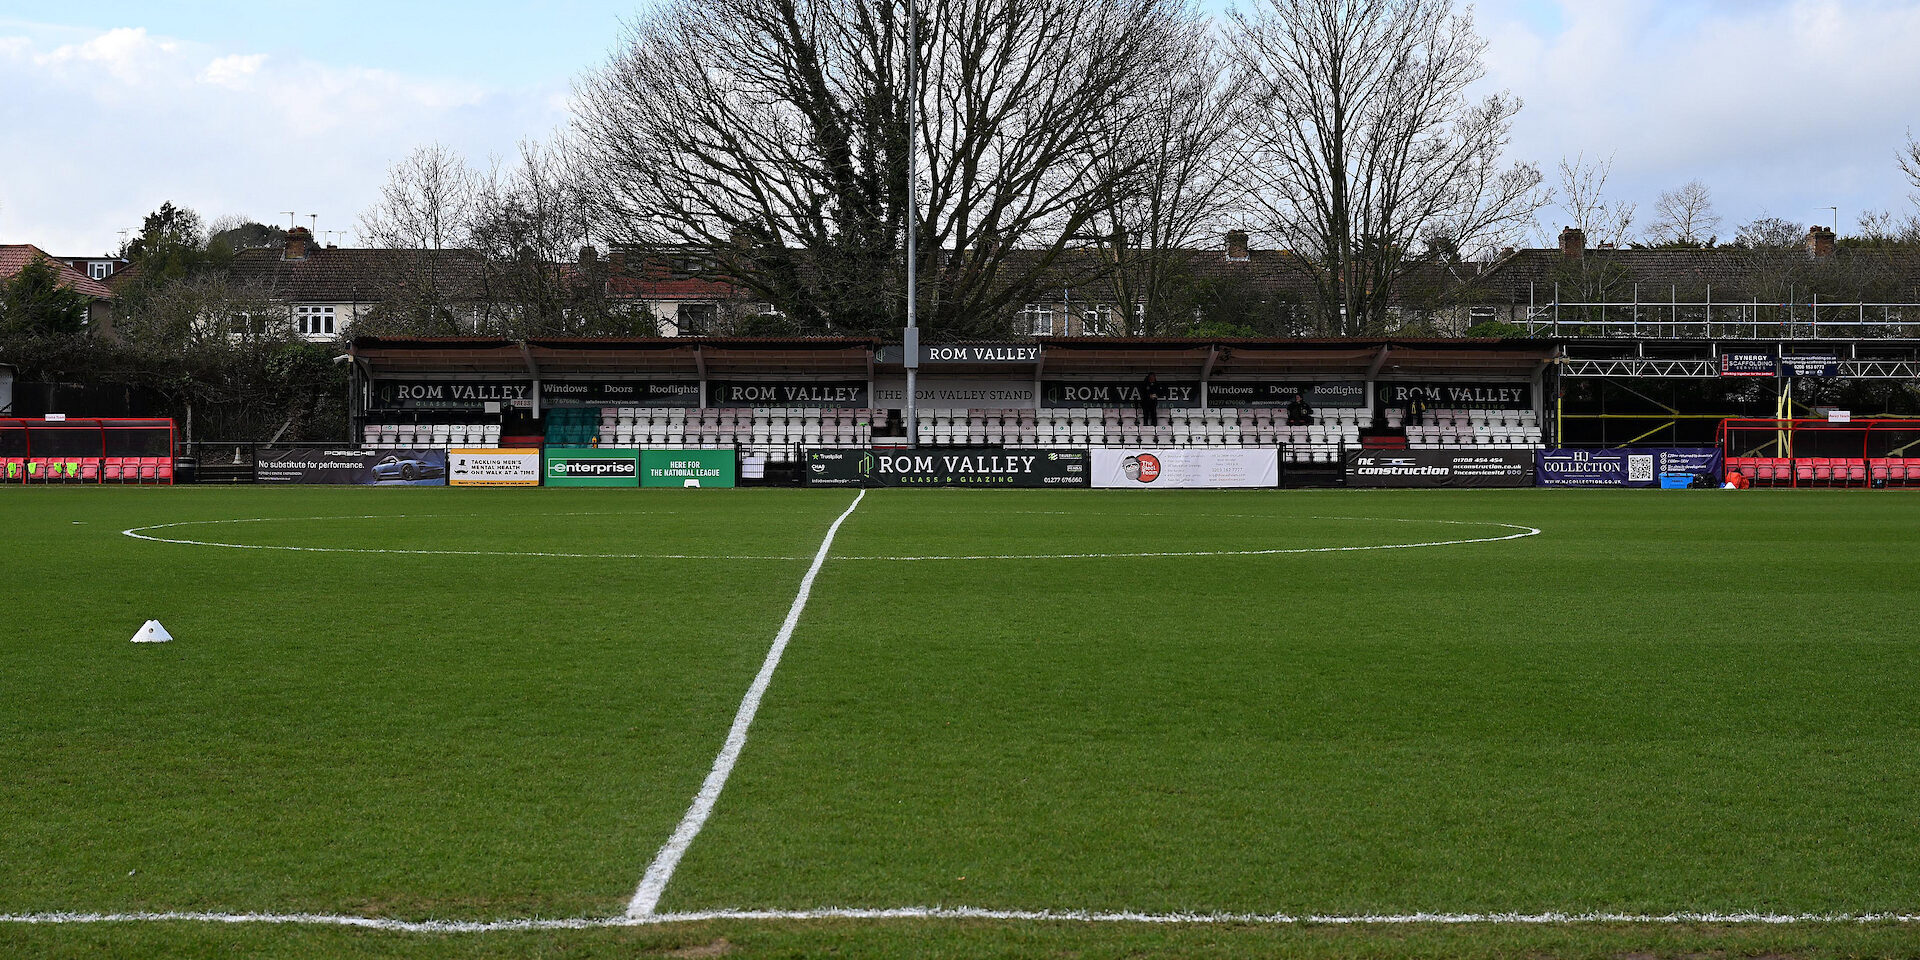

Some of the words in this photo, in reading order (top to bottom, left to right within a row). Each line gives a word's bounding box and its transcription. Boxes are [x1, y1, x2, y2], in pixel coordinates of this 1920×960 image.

[929, 348, 968, 361] ROM
[973, 348, 1037, 361] VALLEY
[398, 386, 444, 399] ROM
[451, 386, 527, 400] VALLEY
[543, 384, 588, 394] Windows
[604, 384, 633, 394] Doors
[650, 384, 699, 395] Rooflights
[732, 386, 777, 400] ROM
[784, 386, 860, 401] VALLEY
[876, 390, 902, 400] THE
[905, 390, 936, 400] OM
[939, 390, 986, 400] VALLEY
[990, 390, 1033, 400] STAND
[1064, 387, 1110, 400] ROM
[1208, 385, 1253, 394] Windows
[1270, 386, 1298, 394] Doors
[1314, 386, 1362, 396] Rooflights
[1448, 388, 1522, 402] VALLEY
[1573, 452, 1590, 462] HJ
[258, 460, 269, 468] No
[270, 460, 306, 469] substitute
[308, 460, 317, 468] for
[319, 460, 365, 470] performance.
[554, 462, 634, 475] enterprise
[879, 456, 934, 473] ROM
[944, 456, 1036, 473] VALLEY
[1544, 462, 1621, 472] COLLECTION
[1358, 466, 1450, 476] construction
